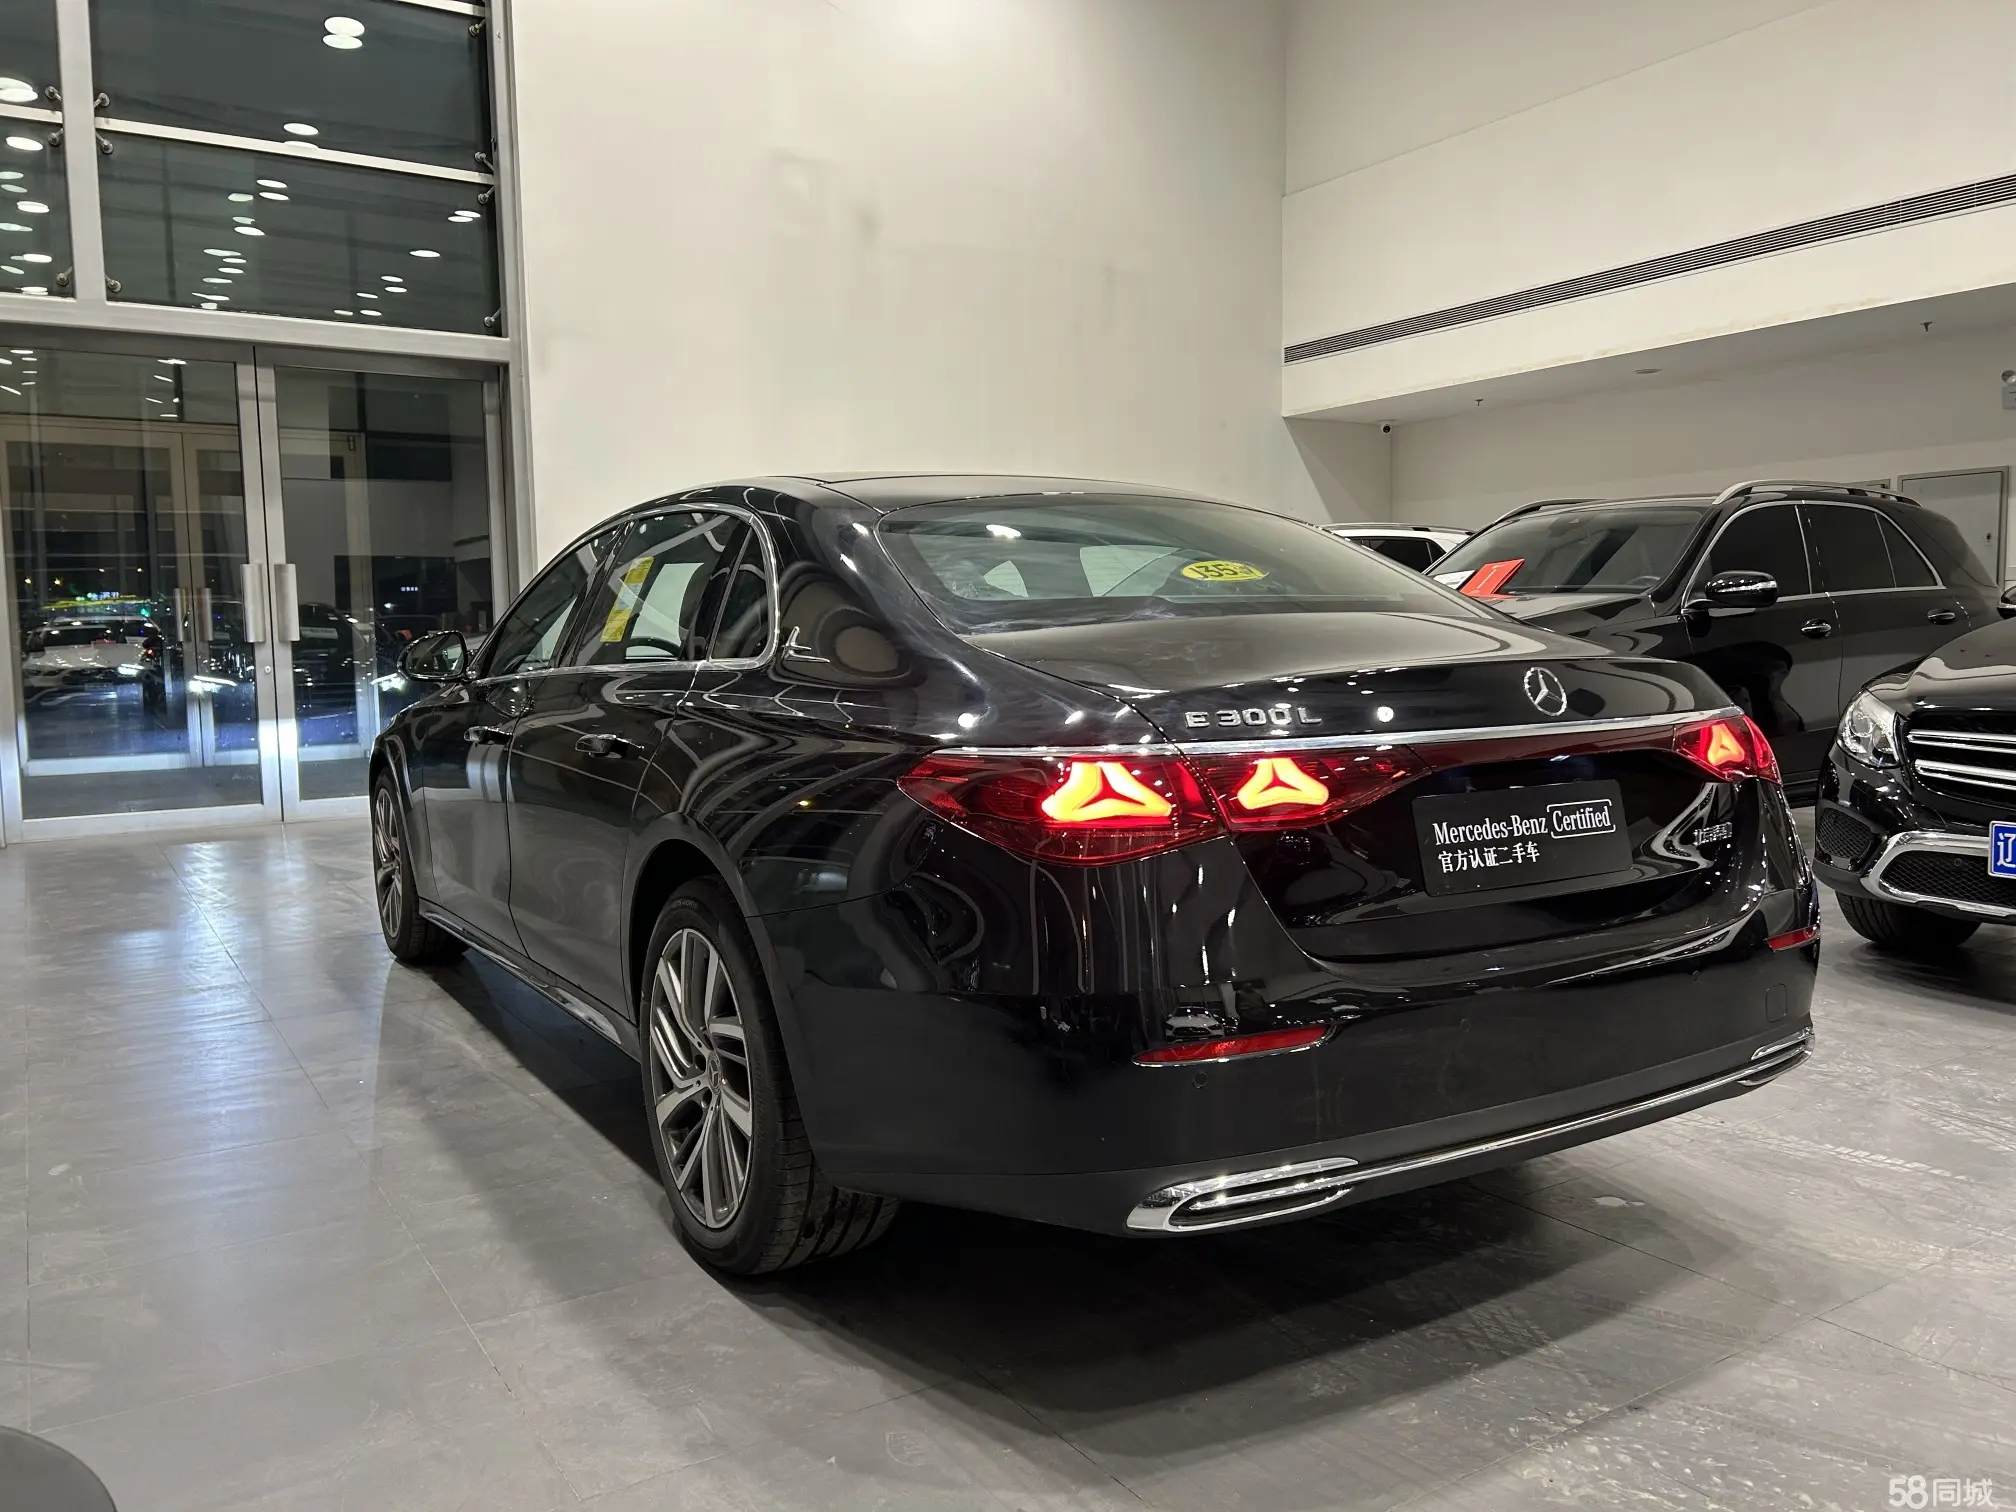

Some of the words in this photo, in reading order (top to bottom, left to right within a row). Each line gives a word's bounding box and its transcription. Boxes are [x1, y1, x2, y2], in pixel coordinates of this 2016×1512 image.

[1184, 711, 1211, 729] E
[1216, 707, 1293, 728] 300
[1297, 707, 1322, 725] L
[1432, 814, 1549, 846] Mercedes-Benz
[1551, 805, 1612, 833] Certified
[1438, 840, 1541, 873] 官方认证二手车
